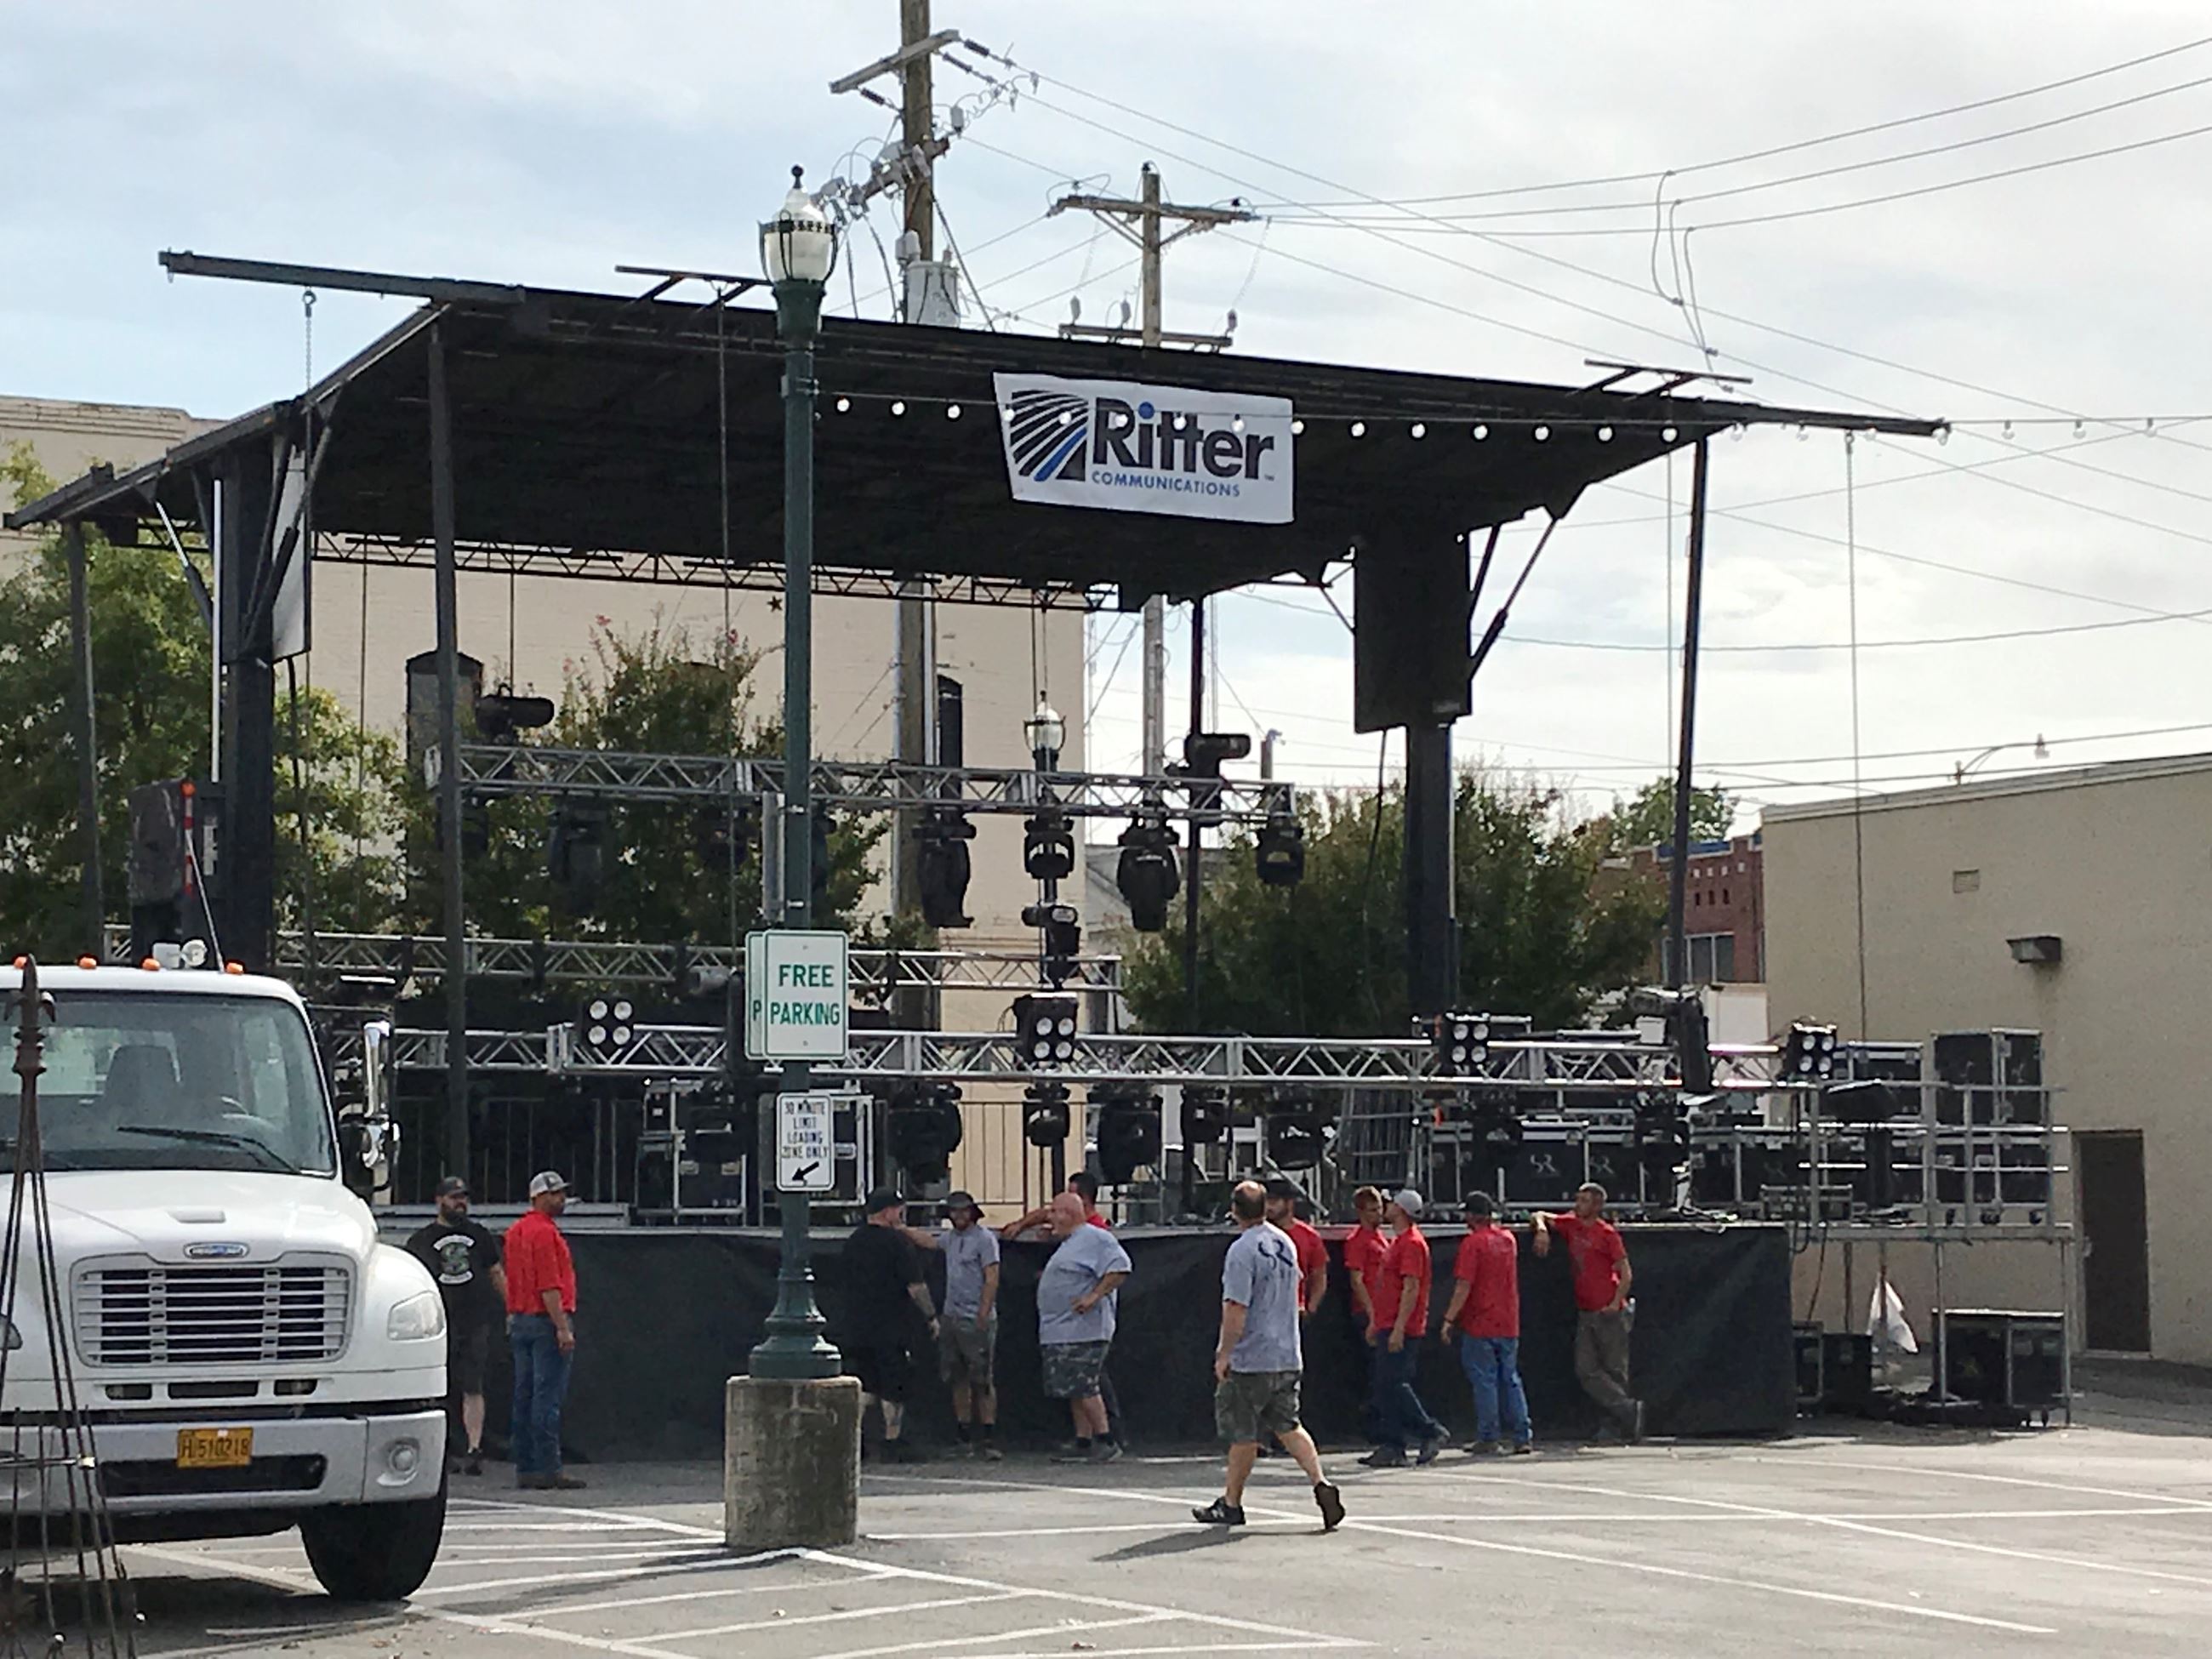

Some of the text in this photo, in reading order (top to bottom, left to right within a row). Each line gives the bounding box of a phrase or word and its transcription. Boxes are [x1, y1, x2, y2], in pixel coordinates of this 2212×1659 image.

[1092, 397, 1274, 480] Ritter
[1092, 470, 1240, 498] COMMUNICATIONS
[779, 964, 834, 987] FREE
[770, 1001, 840, 1025] PARKING
[787, 1131, 823, 1144] LOADING
